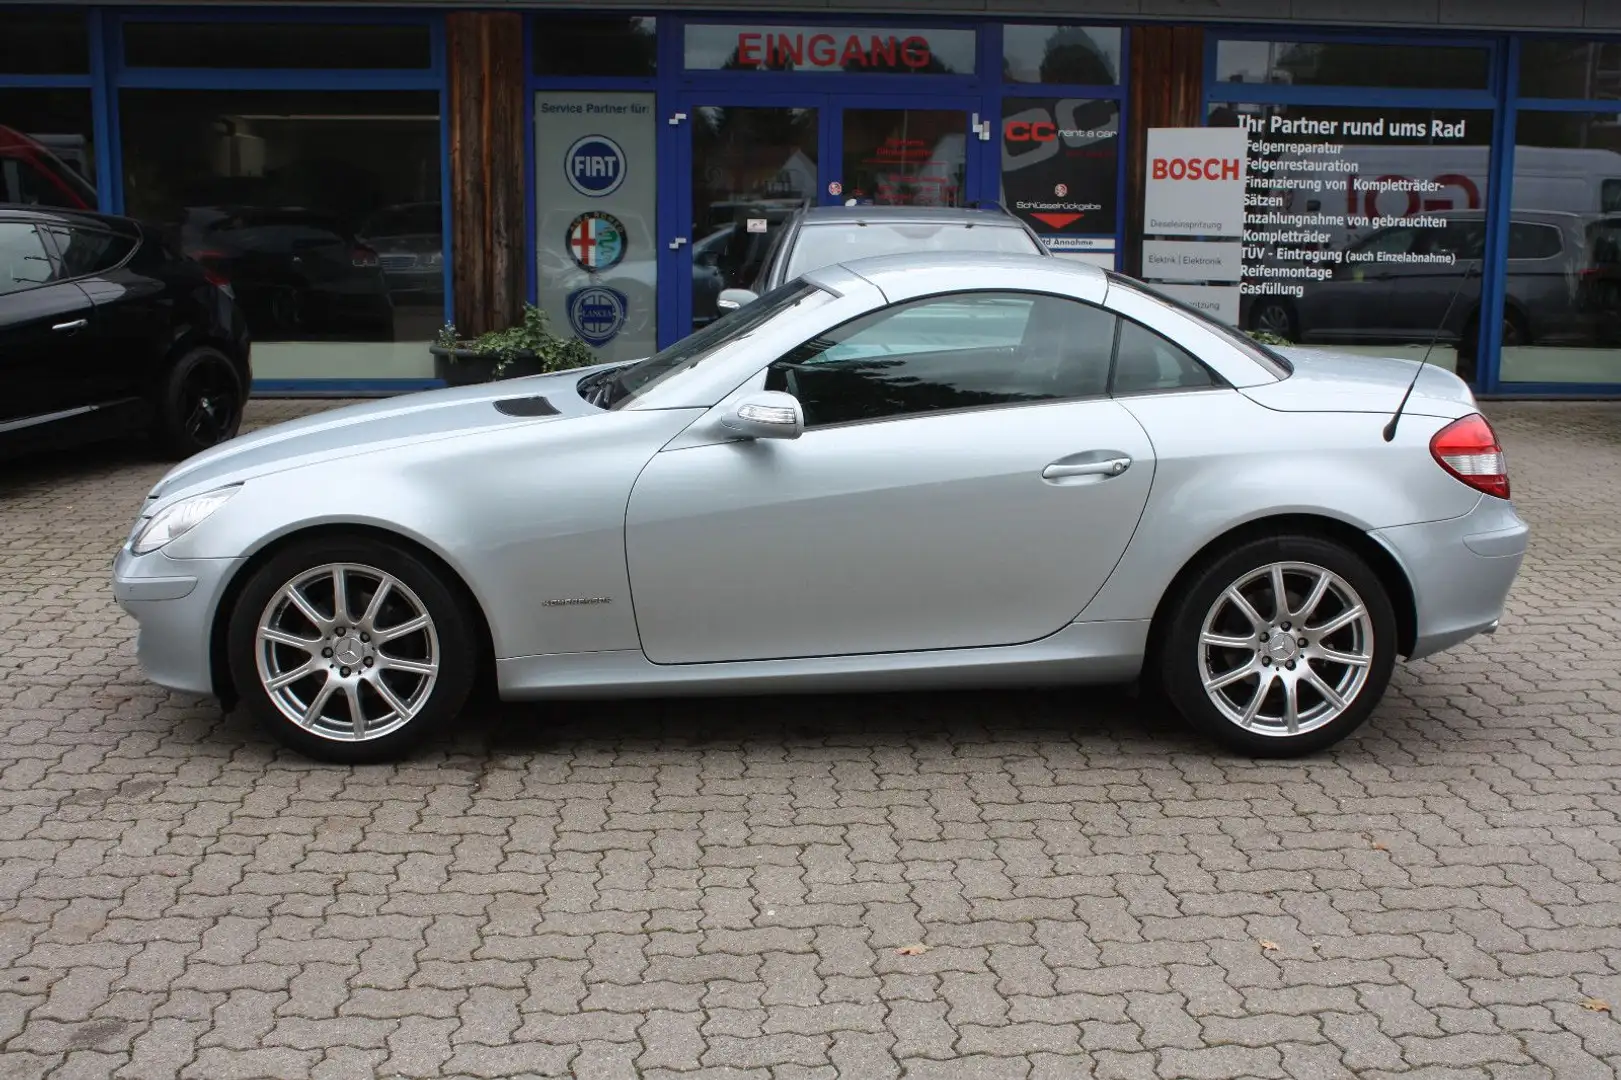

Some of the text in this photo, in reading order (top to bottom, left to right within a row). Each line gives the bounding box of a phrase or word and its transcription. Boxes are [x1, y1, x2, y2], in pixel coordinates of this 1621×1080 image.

[738, 33, 931, 68] EINGANG
[541, 103, 583, 114] Service
[586, 104, 627, 114] Partner
[1005, 121, 1056, 142] CC
[1057, 129, 1085, 138] rent
[1096, 130, 1118, 139] car
[1237, 114, 1466, 138] Ihr Partner rund ums Rad
[1246, 140, 1344, 155] Felgenreparatur
[574, 156, 617, 178] FIAT
[1152, 158, 1240, 181] BOSCH
[1245, 157, 1359, 173] Felgenrestauration
[1244, 175, 1445, 192] Finanzierung von Kompletträder-
[1016, 201, 1102, 212] Schlüsselrückgabe
[1243, 193, 1283, 206] Sätzen
[1150, 218, 1223, 230] Dieseleinspritzung
[1242, 212, 1447, 229] Inzahlungnahme von gebrauchten
[1054, 238, 1094, 246] Annahme
[1243, 229, 1331, 244] Kompletträder
[1148, 254, 1222, 265] Elektrik Elektronik
[1241, 244, 1266, 260] TÜV
[1276, 247, 1343, 264] Eintragung
[1345, 250, 1374, 263] (auch
[1376, 251, 1456, 266] Einzelabnahme)
[1240, 264, 1333, 280] Reifenmontage
[1239, 282, 1304, 297] Gasfüllung
